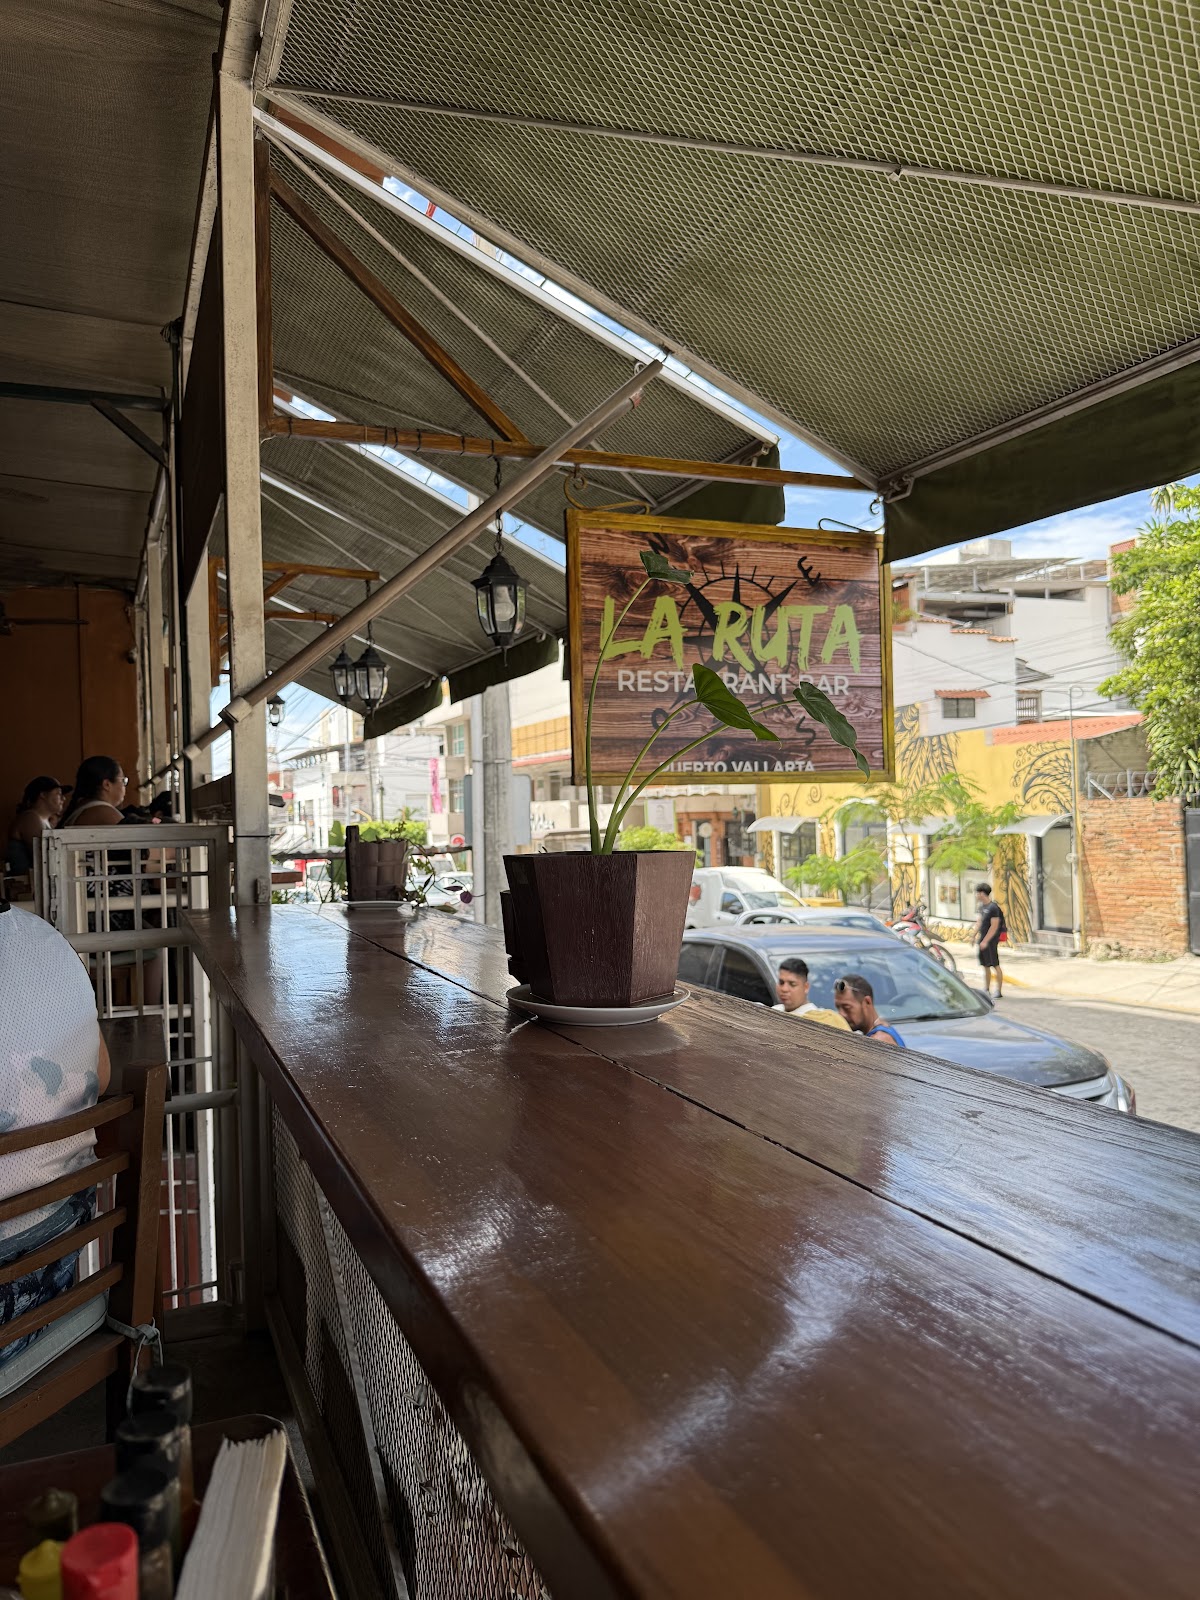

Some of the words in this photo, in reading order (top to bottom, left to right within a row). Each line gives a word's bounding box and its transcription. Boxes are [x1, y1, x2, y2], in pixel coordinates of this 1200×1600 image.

[599, 595, 688, 670] LA
[712, 601, 863, 673] RUTA
[617, 669, 792, 695] RESTARANT
